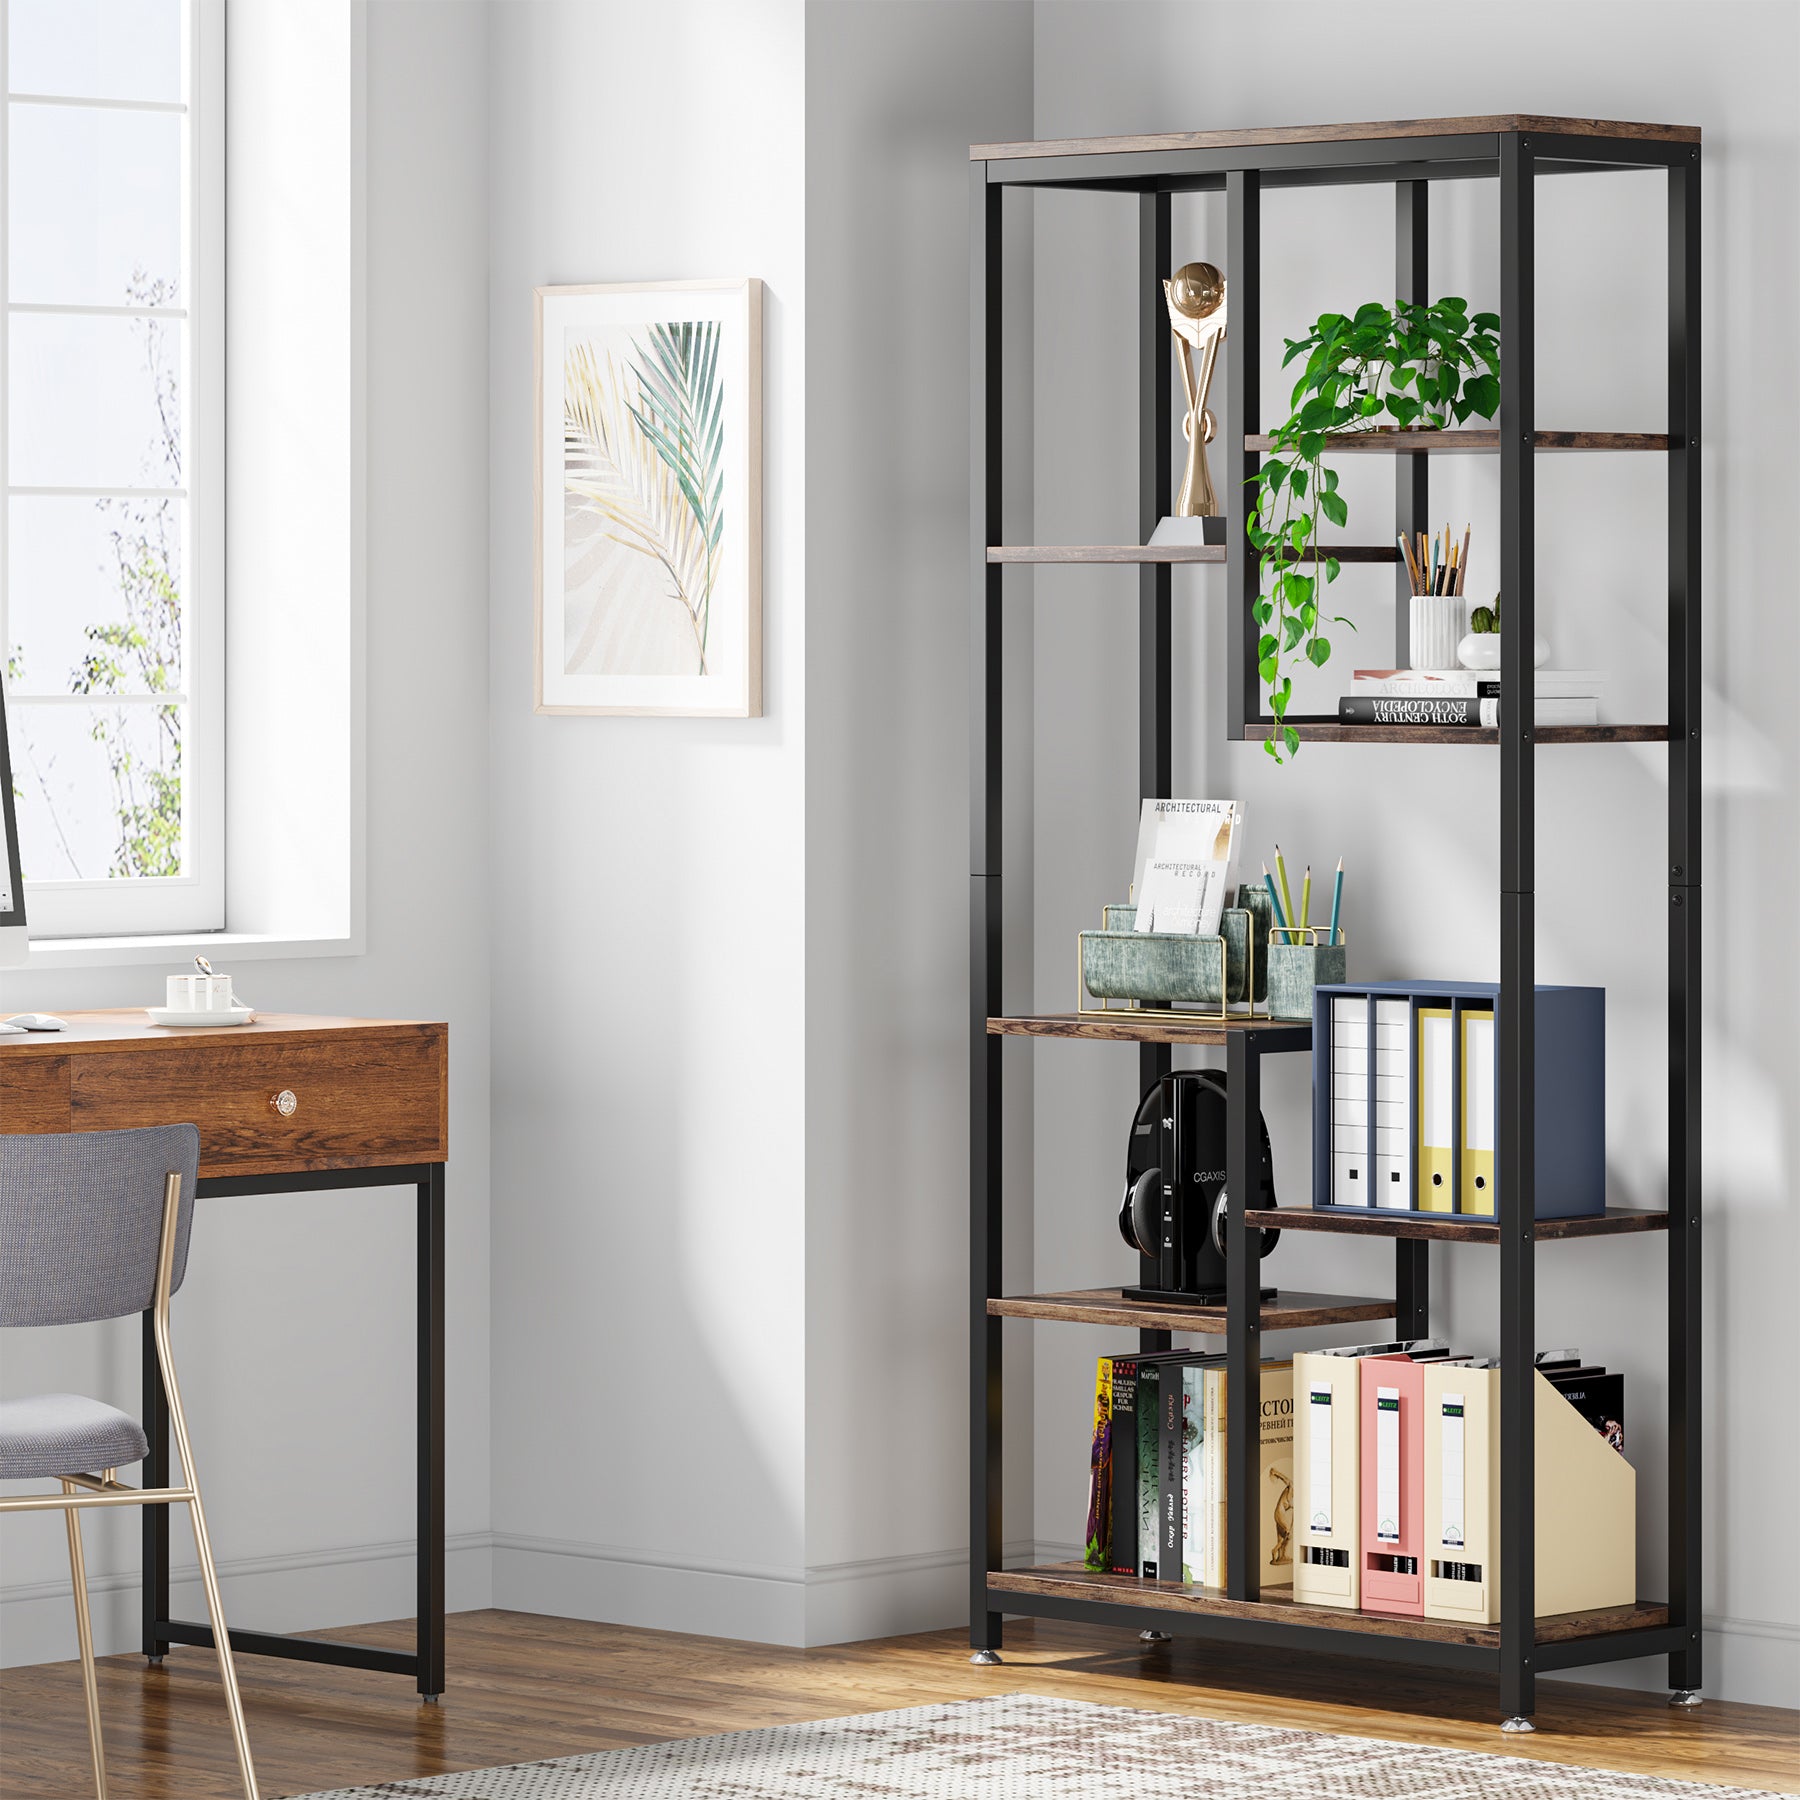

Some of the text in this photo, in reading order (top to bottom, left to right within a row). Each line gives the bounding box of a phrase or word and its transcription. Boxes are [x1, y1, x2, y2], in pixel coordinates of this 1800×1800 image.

[1378, 683, 1469, 695] ARCHEOLOGY
[1372, 700, 1468, 712] ENCYCLOPEDIA
[1374, 711, 1468, 724] 20TH CENTURY
[1155, 802, 1221, 813] ARCHITECTURAL
[1154, 863, 1202, 871] ARCHITECTURAL
[1193, 1170, 1226, 1183] CGAXIS
[1259, 1398, 1293, 1417] СТО
[1182, 1489, 1190, 1540] POTTER
